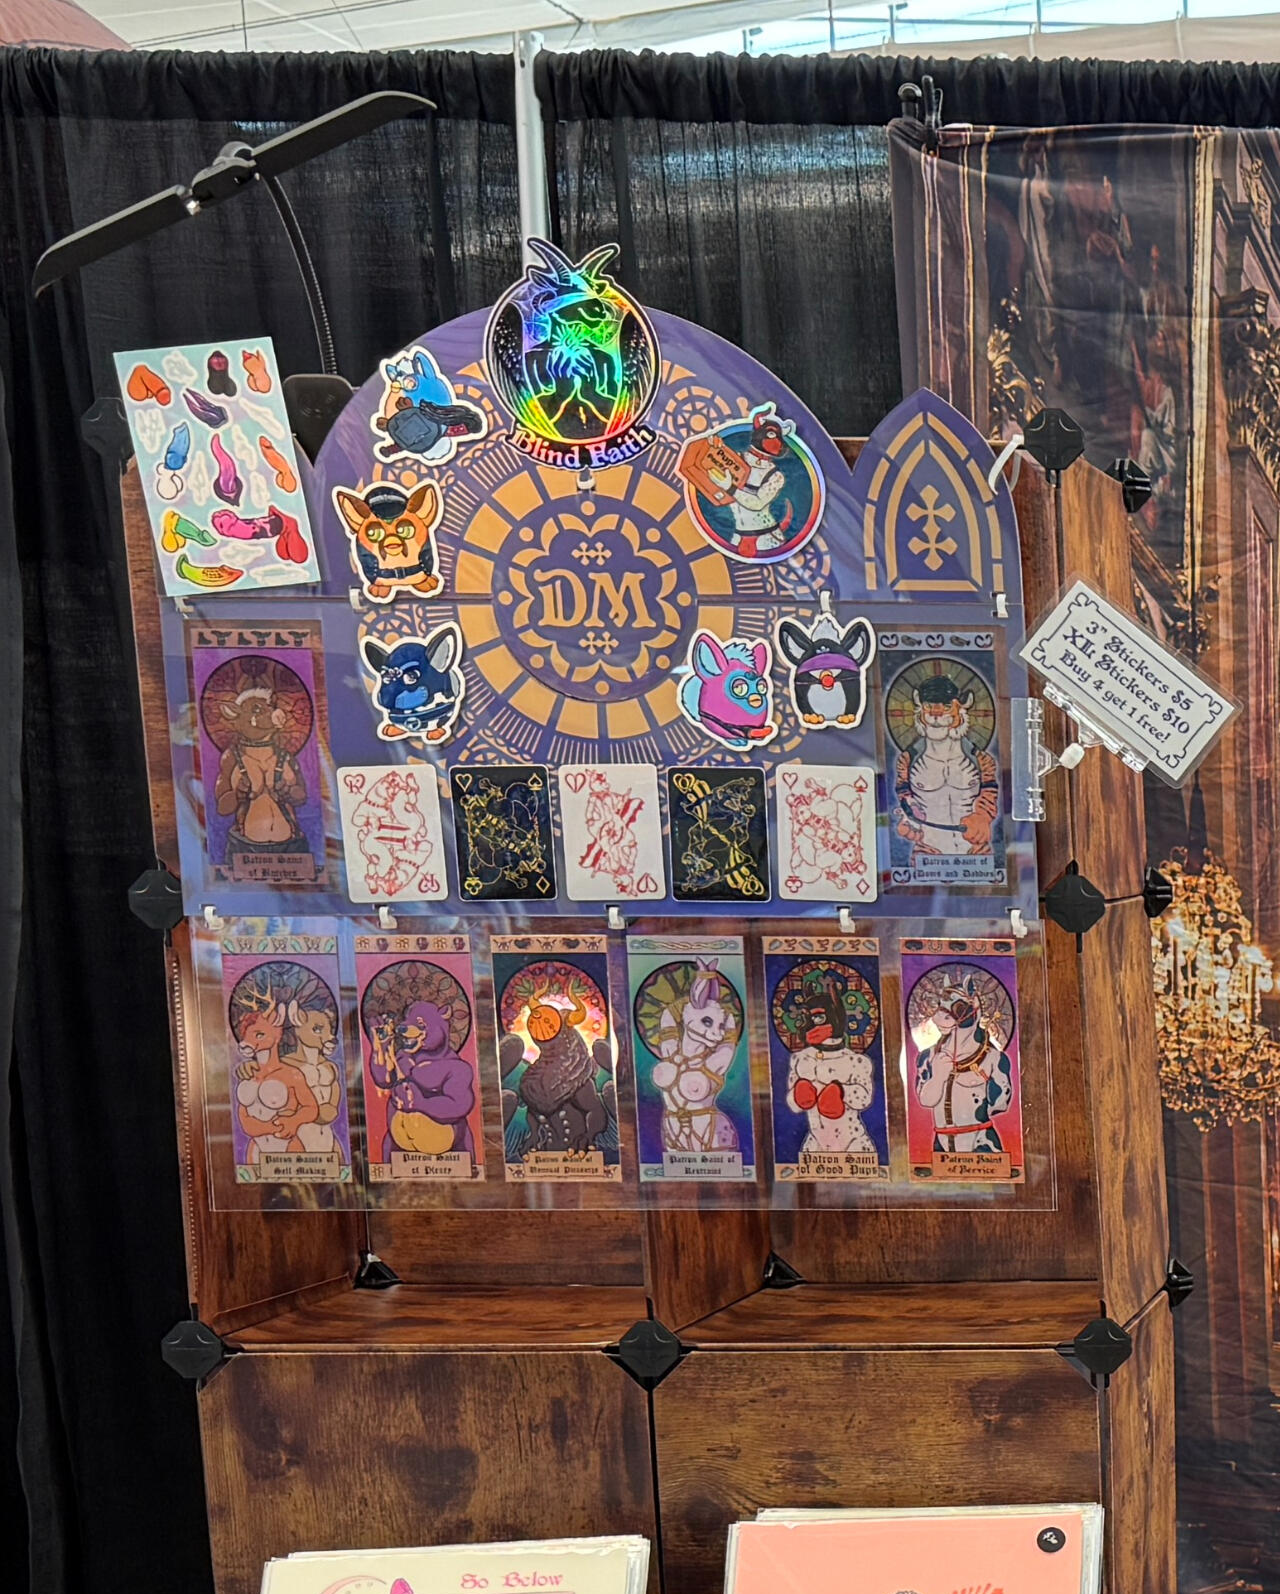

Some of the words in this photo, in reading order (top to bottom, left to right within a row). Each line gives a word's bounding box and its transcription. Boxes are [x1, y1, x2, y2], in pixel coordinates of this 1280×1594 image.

[511, 424, 581, 468] Blind
[586, 428, 652, 467] Faith
[533, 568, 657, 629] DM
[1103, 635, 1170, 695] Stickers
[1171, 689, 1194, 711] $5
[1058, 648, 1091, 683] Buy
[1092, 678, 1104, 691] 4
[1102, 689, 1130, 712] get
[1127, 707, 1136, 718] 1
[1136, 713, 1172, 744] free!
[1094, 653, 1161, 712] Stickers
[1161, 707, 1191, 736] $10
[953, 857, 977, 866] Saint
[980, 857, 988, 865] of
[944, 870, 959, 878] and
[402, 1152, 432, 1163] Patron
[803, 1154, 840, 1165] Patron
[845, 1154, 876, 1165] Saint
[940, 1154, 973, 1164] Patron
[411, 1165, 420, 1175] of
[815, 1164, 844, 1175] Good
[850, 1165, 878, 1177] Pups
[460, 1573, 489, 1589] So
[502, 1571, 565, 1588] Below
